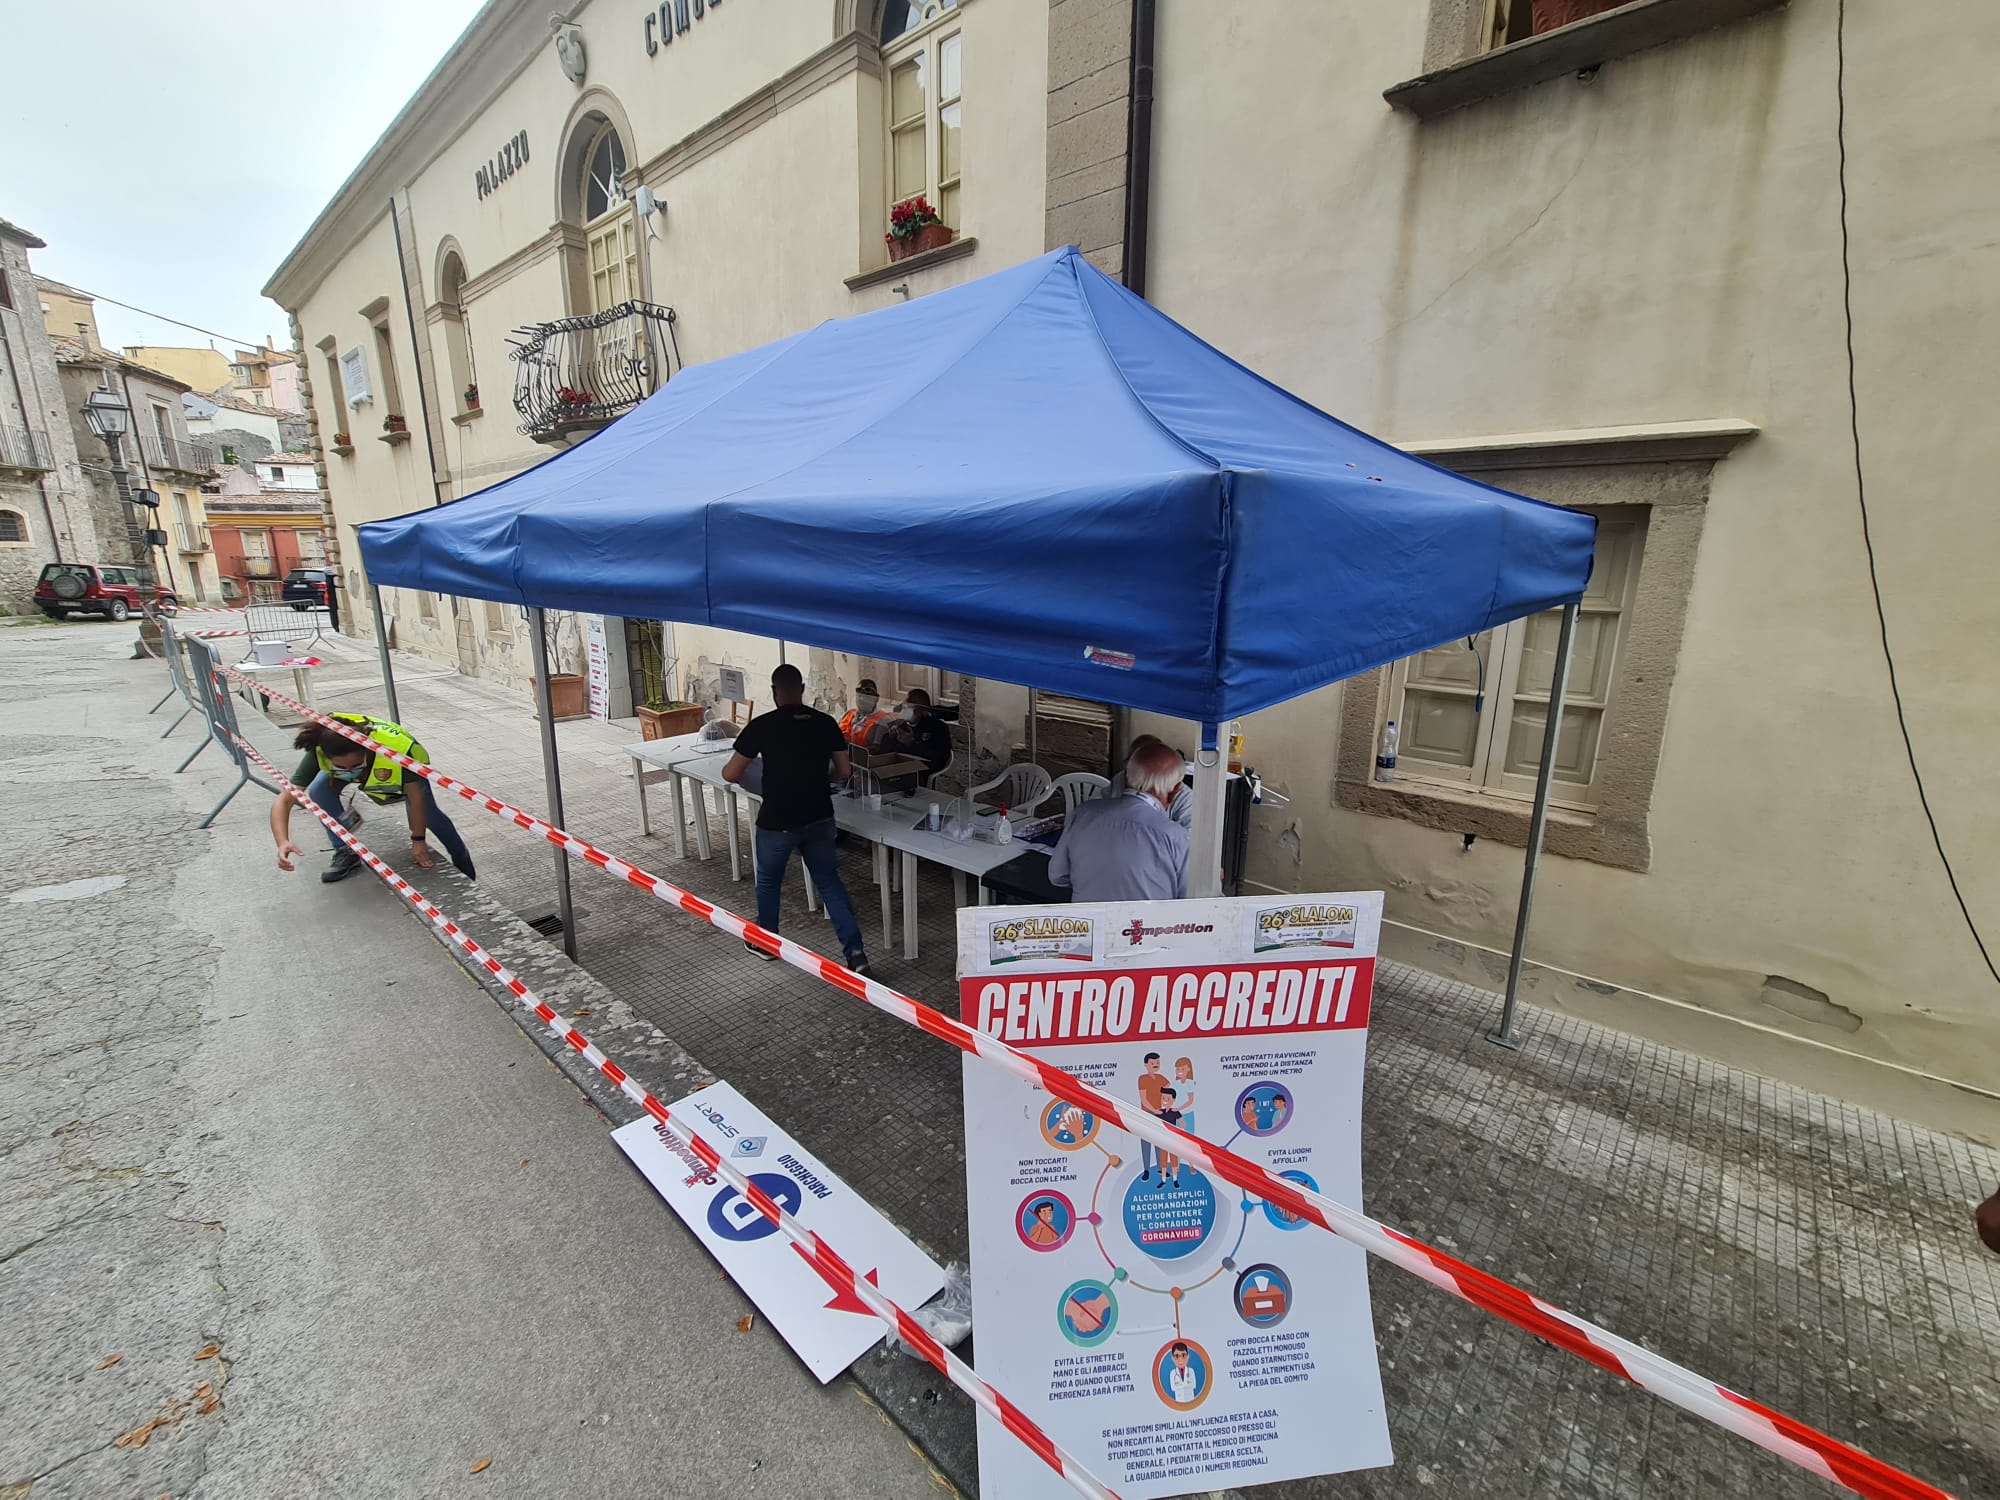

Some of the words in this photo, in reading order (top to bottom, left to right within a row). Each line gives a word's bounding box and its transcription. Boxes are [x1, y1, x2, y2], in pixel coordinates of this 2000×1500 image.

[475, 129, 530, 202] PALAZZO
[644, 0, 722, 57] COMU
[1289, 906, 1354, 923] SLALOM
[1023, 918, 1090, 935] SLALOM
[1121, 923, 1214, 939] competition
[977, 976, 1136, 1041] CENTRO
[1138, 966, 1358, 1034] ACCREDITI
[1241, 1053, 1274, 1061] CONTATTI
[1280, 1059, 1313, 1067] DISTANZA
[694, 1102, 740, 1139] SPORT
[1288, 1147, 1312, 1155] LUOGHI
[1035, 1157, 1068, 1166] TOCCARTI
[1272, 1156, 1308, 1165] AFFOLLATI
[777, 1153, 833, 1199] PARCHEGGIO
[1133, 1193, 1166, 1203] ALCUNE
[1168, 1190, 1205, 1200] SEMPLICI
[1130, 1198, 1208, 1212] RACCOMANDAZIONI
[1136, 1213, 1152, 1221] PER
[1155, 1208, 1204, 1220] CONTENERE
[1138, 1223, 1146, 1231] IL
[1149, 1219, 1188, 1230] CONTAGIO
[1192, 1218, 1202, 1226] DA
[1142, 1229, 1200, 1241] CORONAVIRUS
[1226, 1338, 1246, 1347] COPRI
[1248, 1336, 1270, 1345] BOCCA
[1276, 1333, 1295, 1341] NASO
[1233, 1346, 1273, 1357] FAZZOLETTI
[1274, 1342, 1306, 1352] MONOUSO
[1054, 1358, 1074, 1367] EVITA
[1076, 1356, 1085, 1365] LE
[1086, 1354, 1117, 1364] STRETTE
[1232, 1358, 1259, 1368] QUANDO
[1260, 1352, 1303, 1365] STARNUTISCI
[1053, 1368, 1073, 1378] MANO
[1080, 1366, 1091, 1375] GLI
[1092, 1363, 1128, 1374] ABBRACCI
[1261, 1364, 1301, 1375] ALTRIMENTI
[1302, 1362, 1315, 1371] USA
[1051, 1380, 1067, 1389] FINO
[1074, 1377, 1103, 1388] QUANDO
[1104, 1374, 1131, 1384] QUESTA
[1238, 1380, 1248, 1389] LA
[1249, 1378, 1269, 1388] PIEGA
[1270, 1376, 1283, 1385] DEL
[1284, 1374, 1309, 1383] GOMITO
[1048, 1388, 1091, 1401] EMERGENZA
[1112, 1384, 1135, 1394] FINITA
[1102, 1430, 1111, 1438] SE
[1112, 1428, 1125, 1437] HAI
[1126, 1424, 1153, 1435] SINTOMI
[1154, 1422, 1175, 1432] SIMILI
[1176, 1416, 1229, 1429] ALL'INFLUENZA
[1230, 1412, 1251, 1422] RESTA
[1108, 1440, 1123, 1449] NON
[1124, 1436, 1154, 1447] RECARTI
[1155, 1434, 1164, 1443] AL
[1166, 1431, 1194, 1442] PRONTO
[1194, 1428, 1231, 1439] SOCCORSO
[1238, 1422, 1264, 1433] PRESSO
[1265, 1420, 1276, 1429] GLI
[1108, 1450, 1129, 1461] STUDI
[1156, 1446, 1167, 1455] MA
[1168, 1442, 1204, 1454] CONTATTA
[1205, 1440, 1211, 1449] IL
[1212, 1438, 1238, 1448] MEDICO
[1238, 1436, 1246, 1444] DI
[1246, 1432, 1279, 1443] MEDICINA
[1170, 1454, 1201, 1465] PEDIATRI
[1202, 1452, 1209, 1461] DI
[1210, 1449, 1235, 1460] LIBERA
[1124, 1474, 1135, 1483] LA
[1136, 1470, 1167, 1481] GUARDIA
[1168, 1466, 1194, 1478] MEDICA
[1196, 1466, 1200, 1474] O
[1205, 1461, 1231, 1472] NUMERI
[1232, 1457, 1268, 1469] REGIONALI
